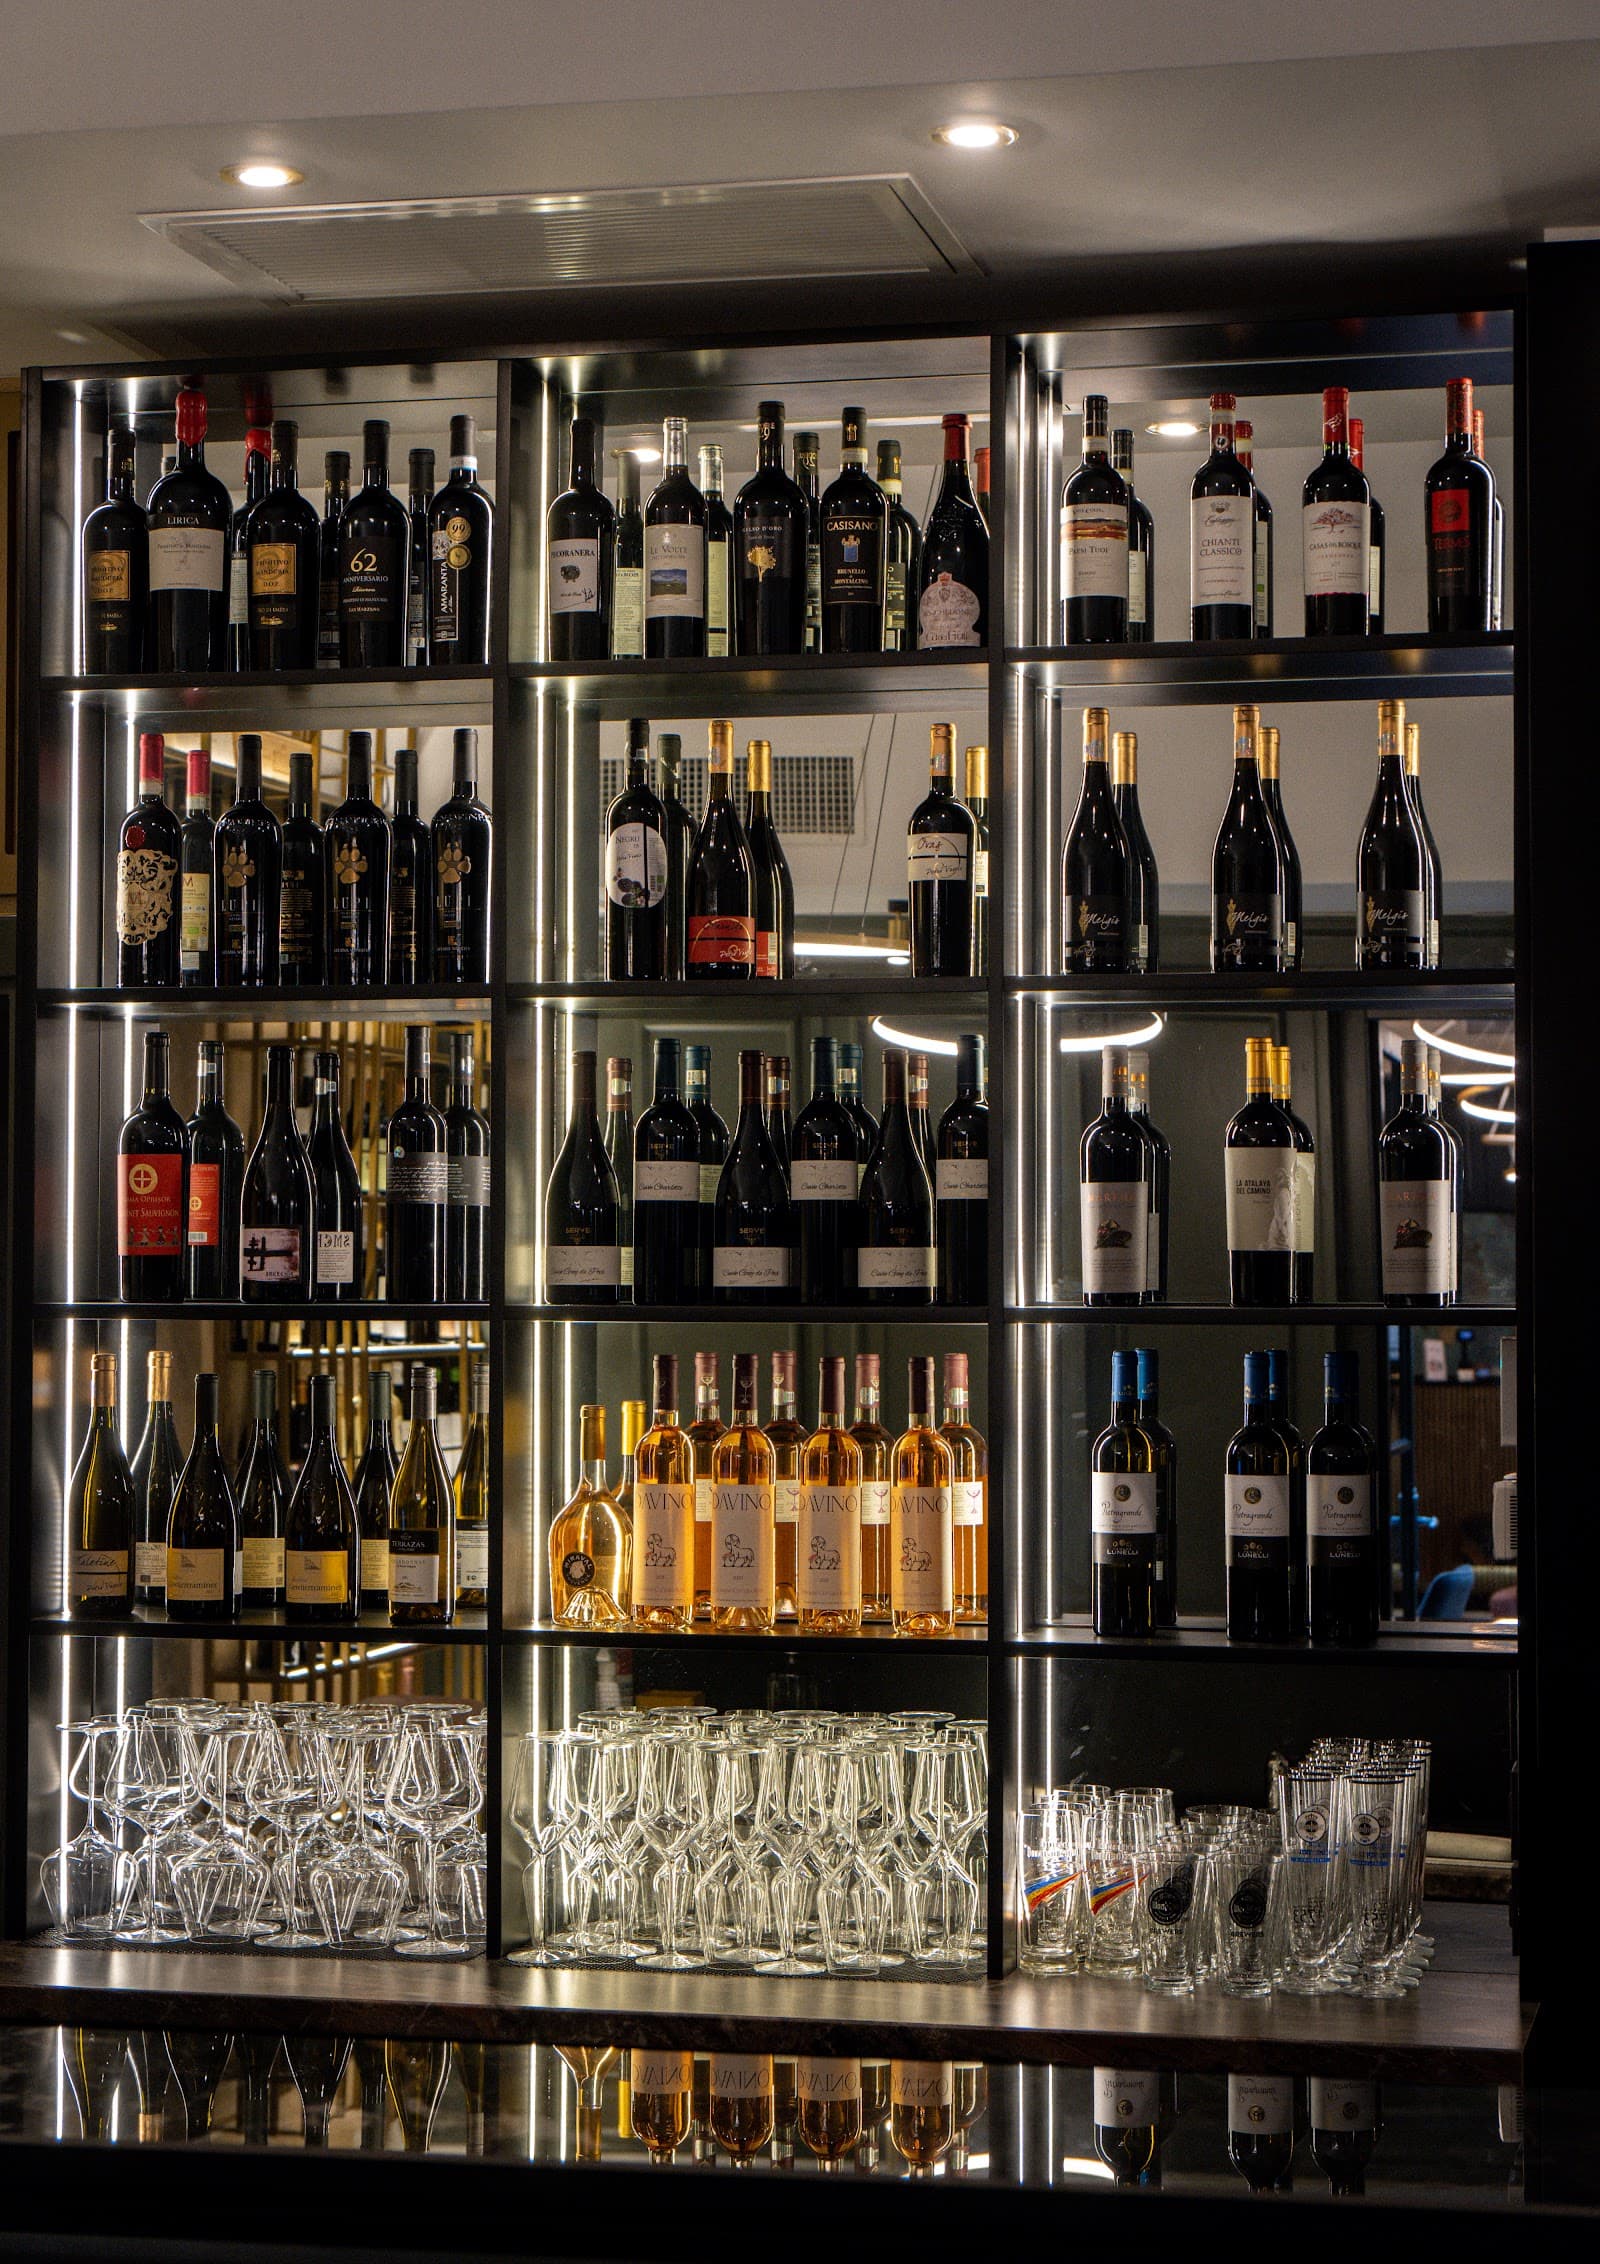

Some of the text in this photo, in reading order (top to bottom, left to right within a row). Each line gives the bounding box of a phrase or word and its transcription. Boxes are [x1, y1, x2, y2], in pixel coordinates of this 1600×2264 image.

[167, 516, 200, 525] LIRICA
[826, 520, 878, 532] CASISANO
[452, 523, 466, 535] 99
[1202, 538, 1241, 548] CHIANTI
[1200, 547, 1242, 557] CLASSICO
[350, 547, 378, 573] 62
[343, 575, 389, 584] ANNIVERSARIO
[440, 561, 449, 614] AMARANTA
[221, 899, 256, 912] LUI
[436, 895, 471, 908] LUI
[1245, 1179, 1271, 1187] ATALAYA
[711, 1492, 771, 1511] DAVINO
[797, 1494, 858, 1513] DAVINO
[890, 1495, 949, 1514] DAVINO
[392, 1540, 425, 1549] TERRAZAS
[1237, 1551, 1269, 1559] LUNELLI
[564, 1555, 593, 1570] MIRAVAL
